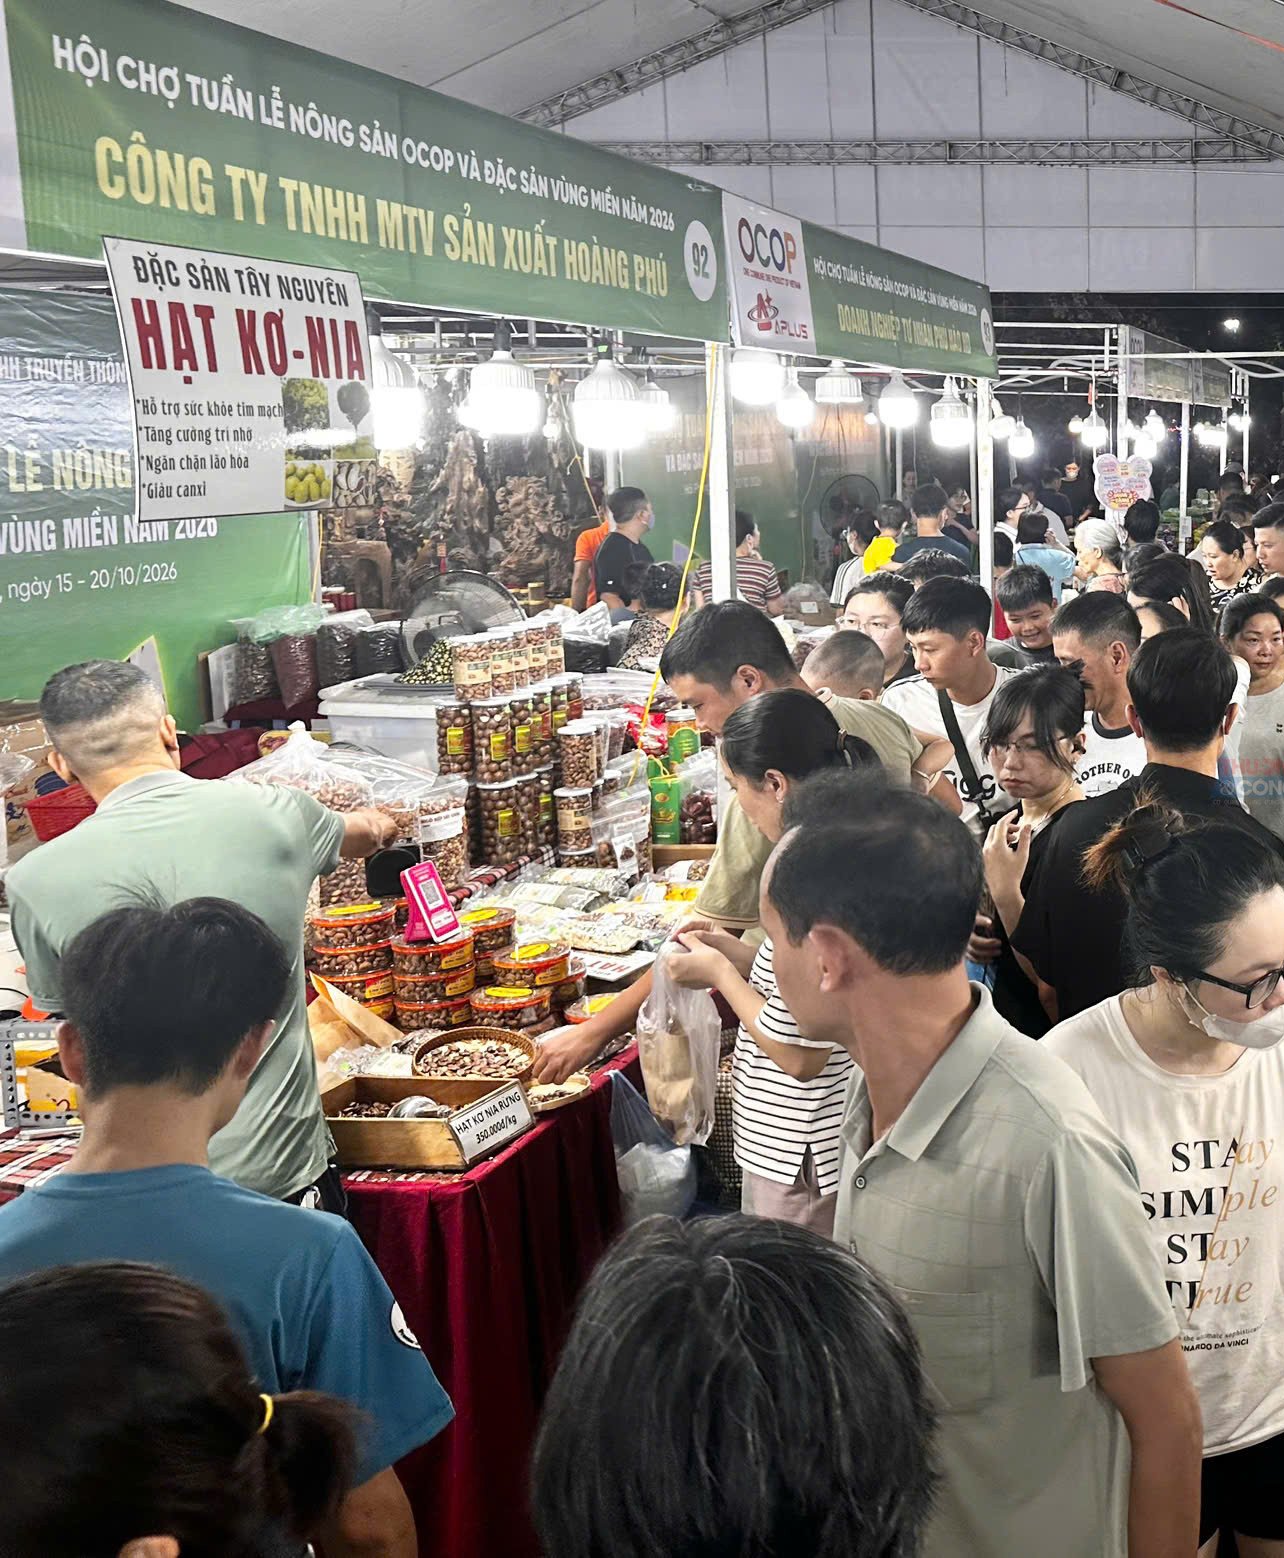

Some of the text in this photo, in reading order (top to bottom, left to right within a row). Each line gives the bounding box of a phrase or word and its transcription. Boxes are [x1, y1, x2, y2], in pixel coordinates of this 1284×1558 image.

[52, 34, 676, 231] HỘI CHỢ TUẦN LỄ NÔNG SẢN OCOP VÀ ĐẶC SẢN VÙNG MIỀN NĂM 2026
[95, 130, 668, 297] CÔNG TY TNHH MTV SẢN XUẤT HOÀNG PHÚ
[691, 242, 710, 279] 92
[738, 217, 797, 274] OCOP
[132, 251, 349, 307] ĐẶC SẢN TÂY NGUYÊN
[837, 303, 870, 336] DOANH
[131, 297, 365, 384] HẠT KƠ-NIA
[87, 356, 126, 384] THÔN
[257, 403, 285, 419] mạch
[54, 440, 133, 489] NÔNG
[63, 506, 118, 549] MIỀN
[8, 575, 51, 602] ngày
[56, 573, 73, 593] 15
[90, 562, 178, 589] 20/10/2026
[484, 1105, 499, 1119] NIA
[1181, 1338, 1249, 1352] NARDO DA VINCI
